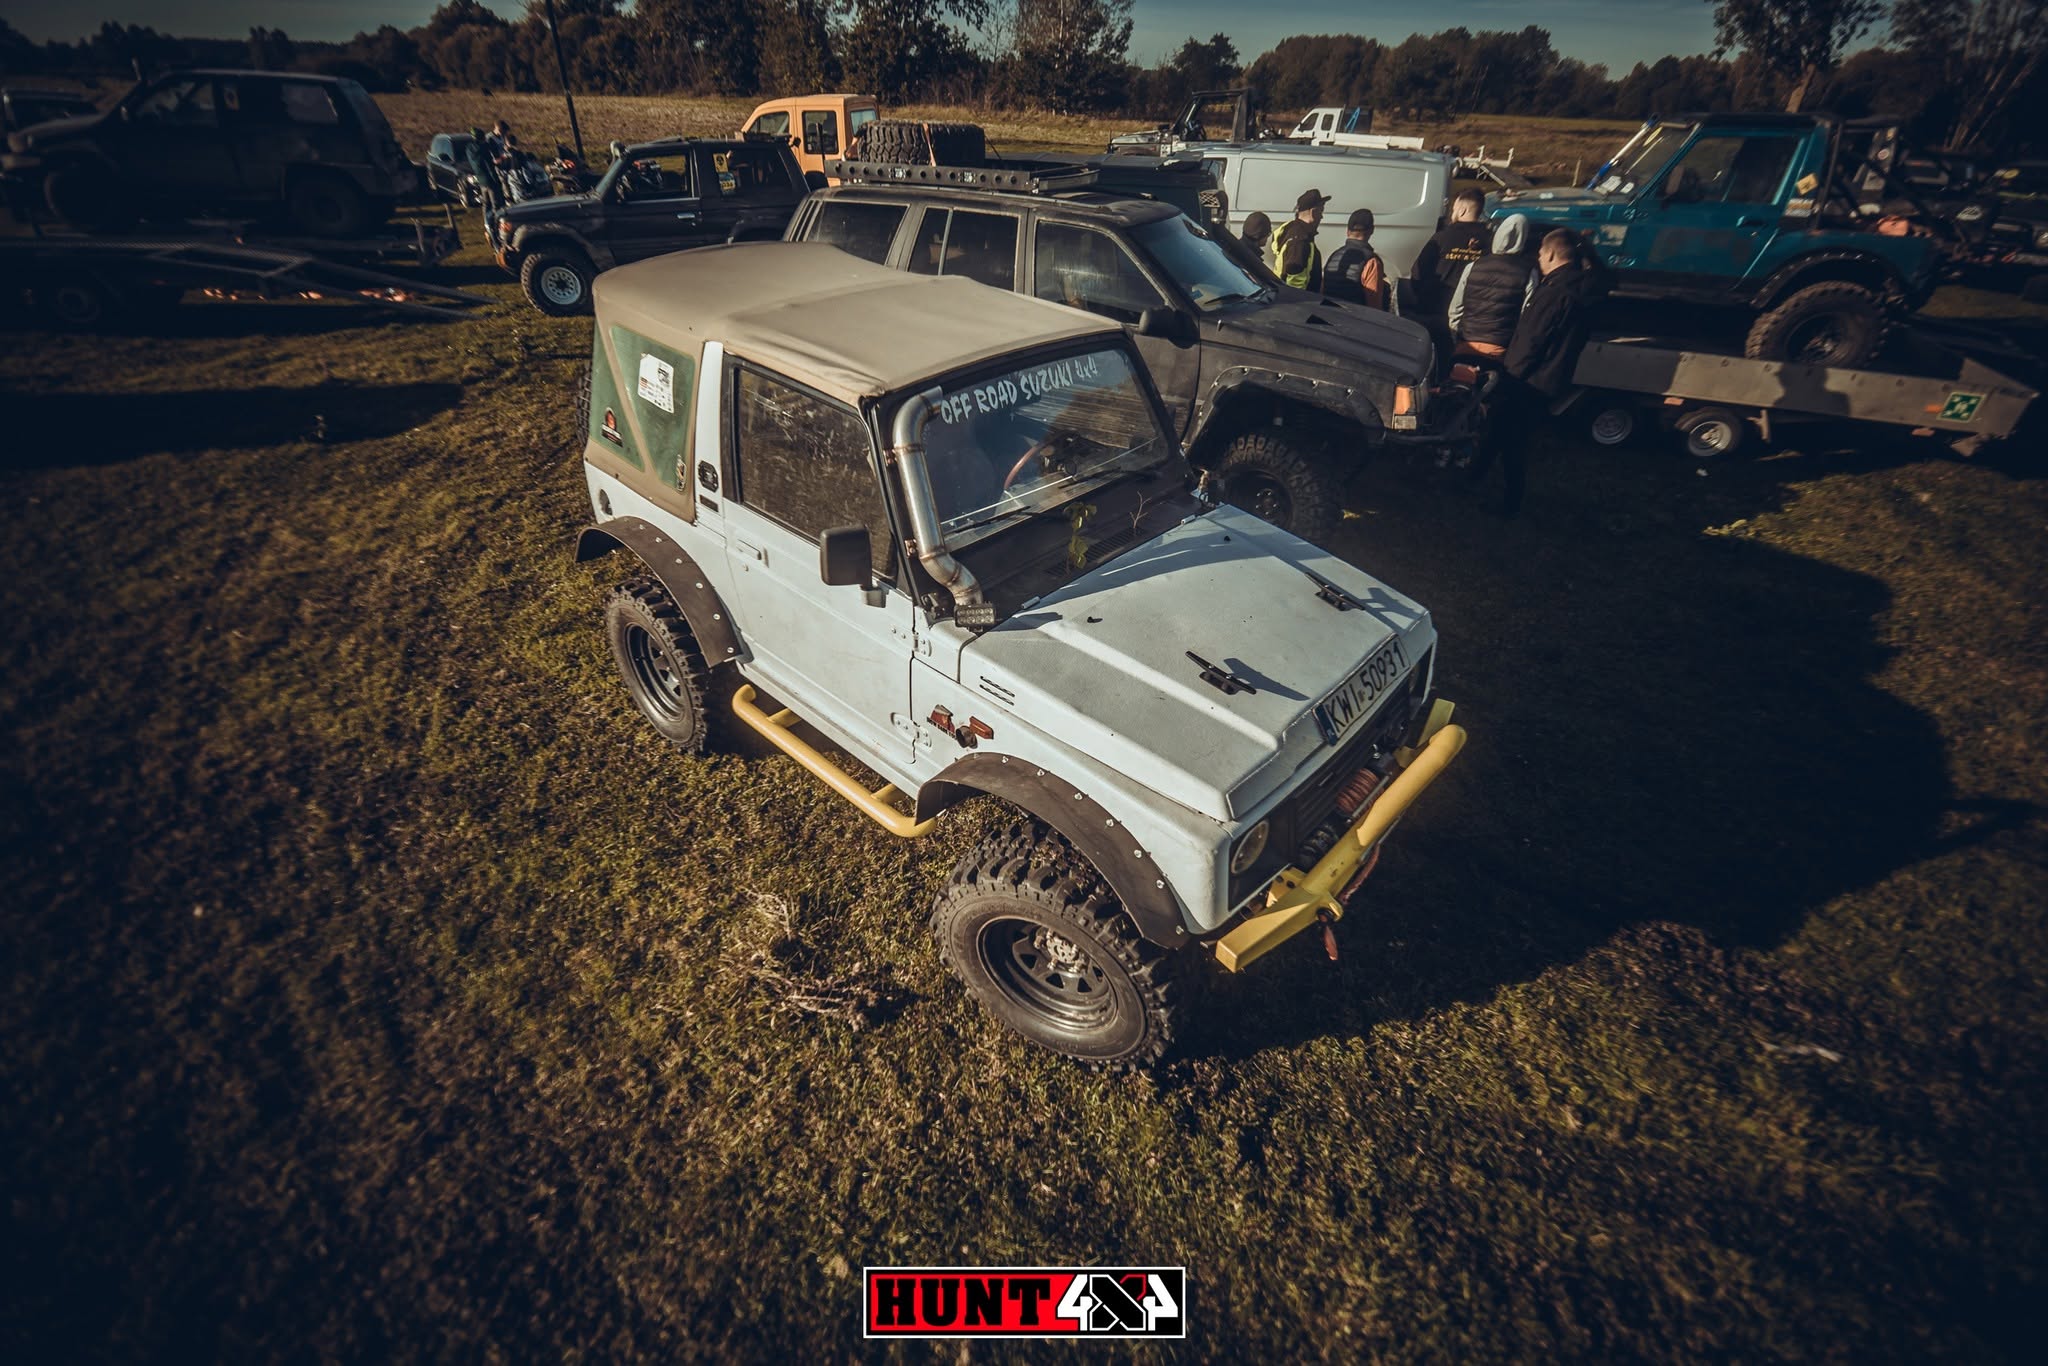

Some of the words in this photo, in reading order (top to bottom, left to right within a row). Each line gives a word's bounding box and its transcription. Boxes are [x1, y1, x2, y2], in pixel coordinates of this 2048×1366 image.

[940, 392, 973, 424] OFF
[974, 379, 1018, 413] ROAD
[1020, 361, 1073, 400] SUZUKI
[1324, 683, 1362, 733] KWI
[1360, 641, 1406, 701] 50931
